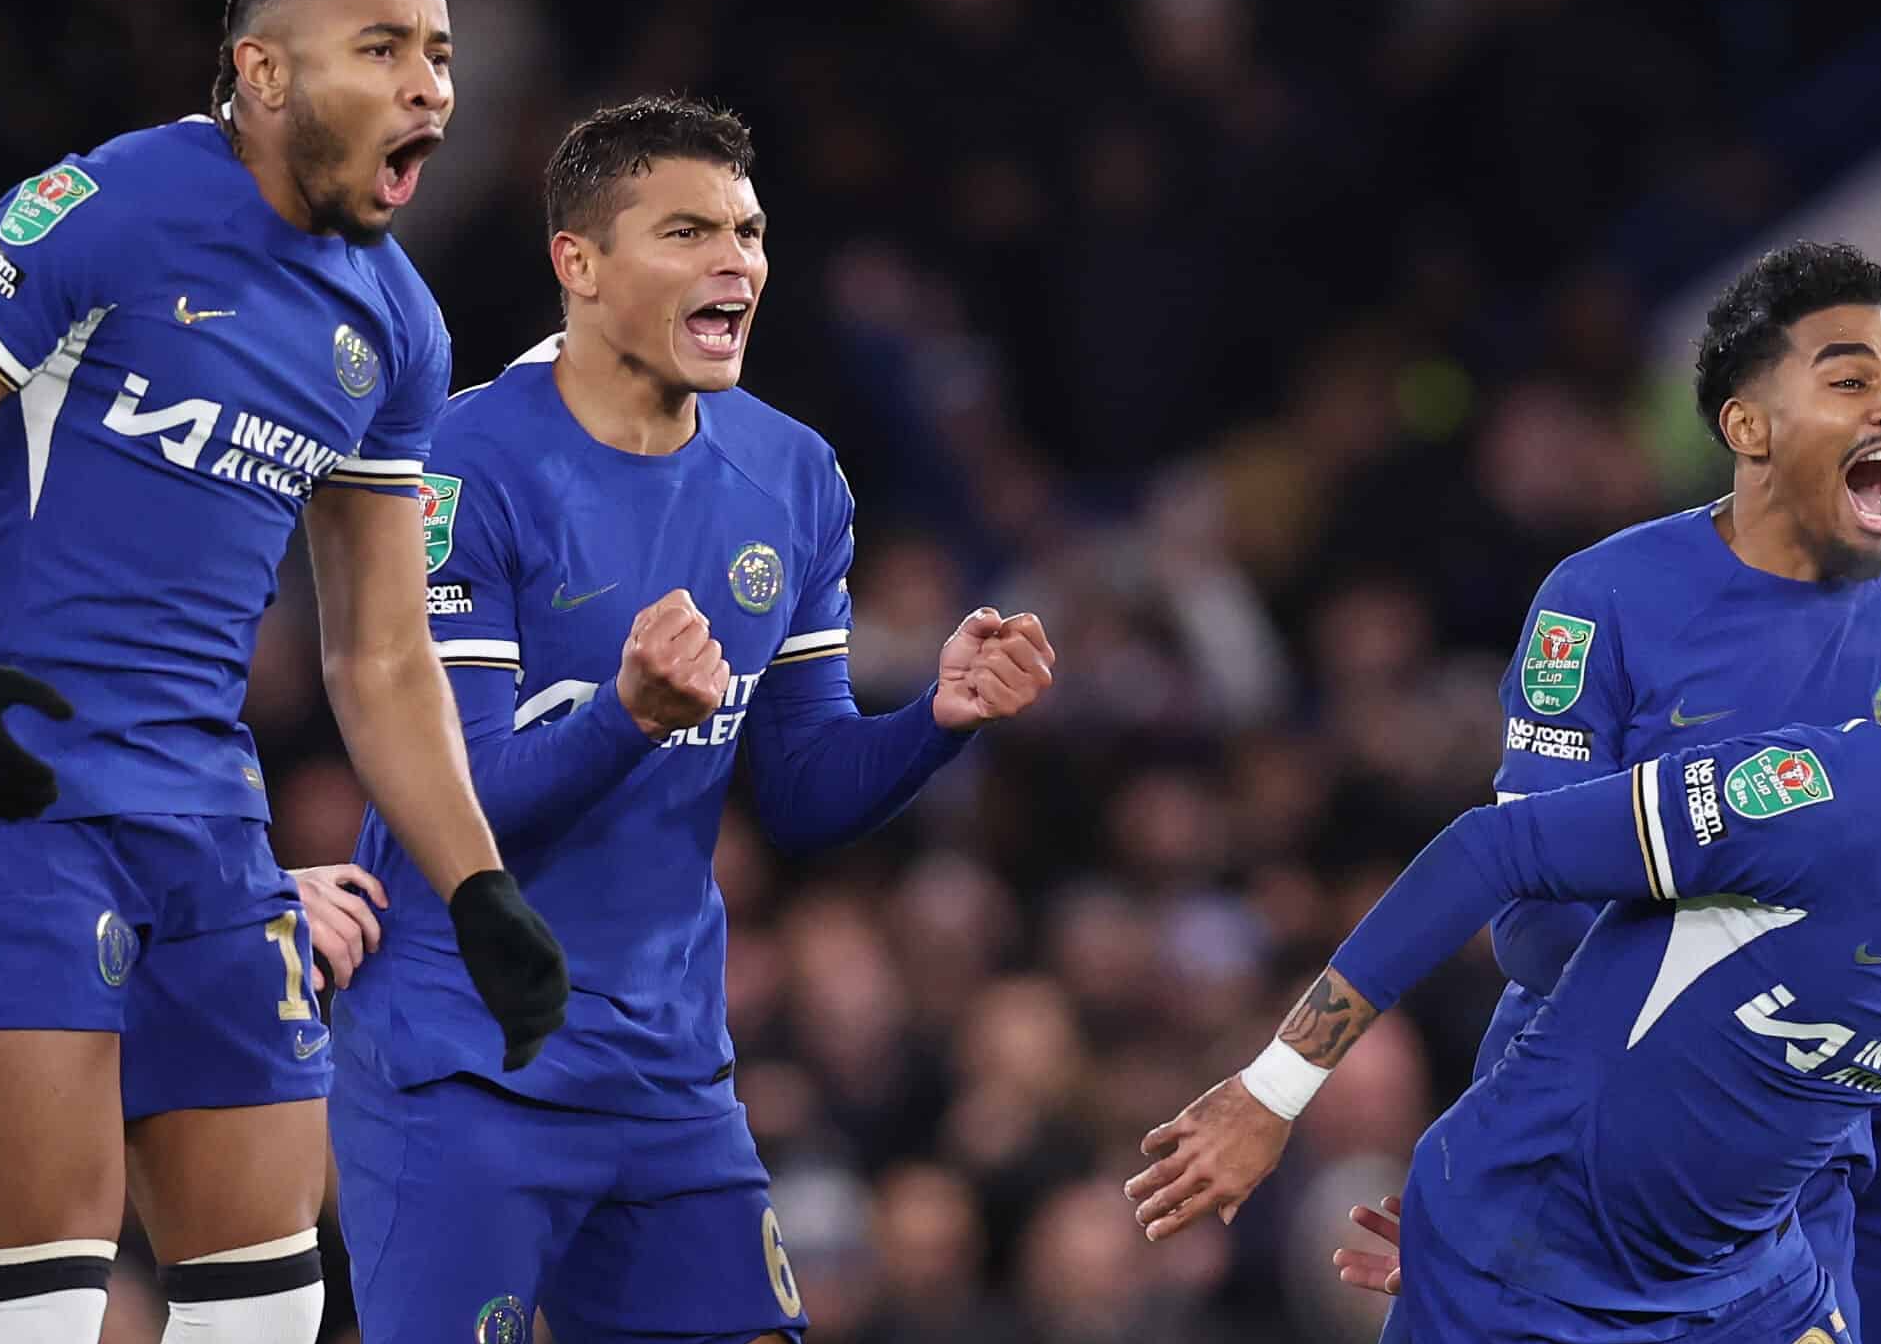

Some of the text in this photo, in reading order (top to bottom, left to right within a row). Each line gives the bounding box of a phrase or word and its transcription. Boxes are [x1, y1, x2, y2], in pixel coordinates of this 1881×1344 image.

[1527, 658, 1580, 669] Carabao
[1537, 670, 1563, 684] Cup
[1508, 717, 1584, 746] No room
[1531, 740, 1591, 761] racism
[1752, 772, 1772, 796] Cup
[1758, 755, 1793, 805] Carabao
[1684, 761, 1712, 846] for racism
[1698, 758, 1723, 833] No room
[762, 1207, 801, 1318] 6
